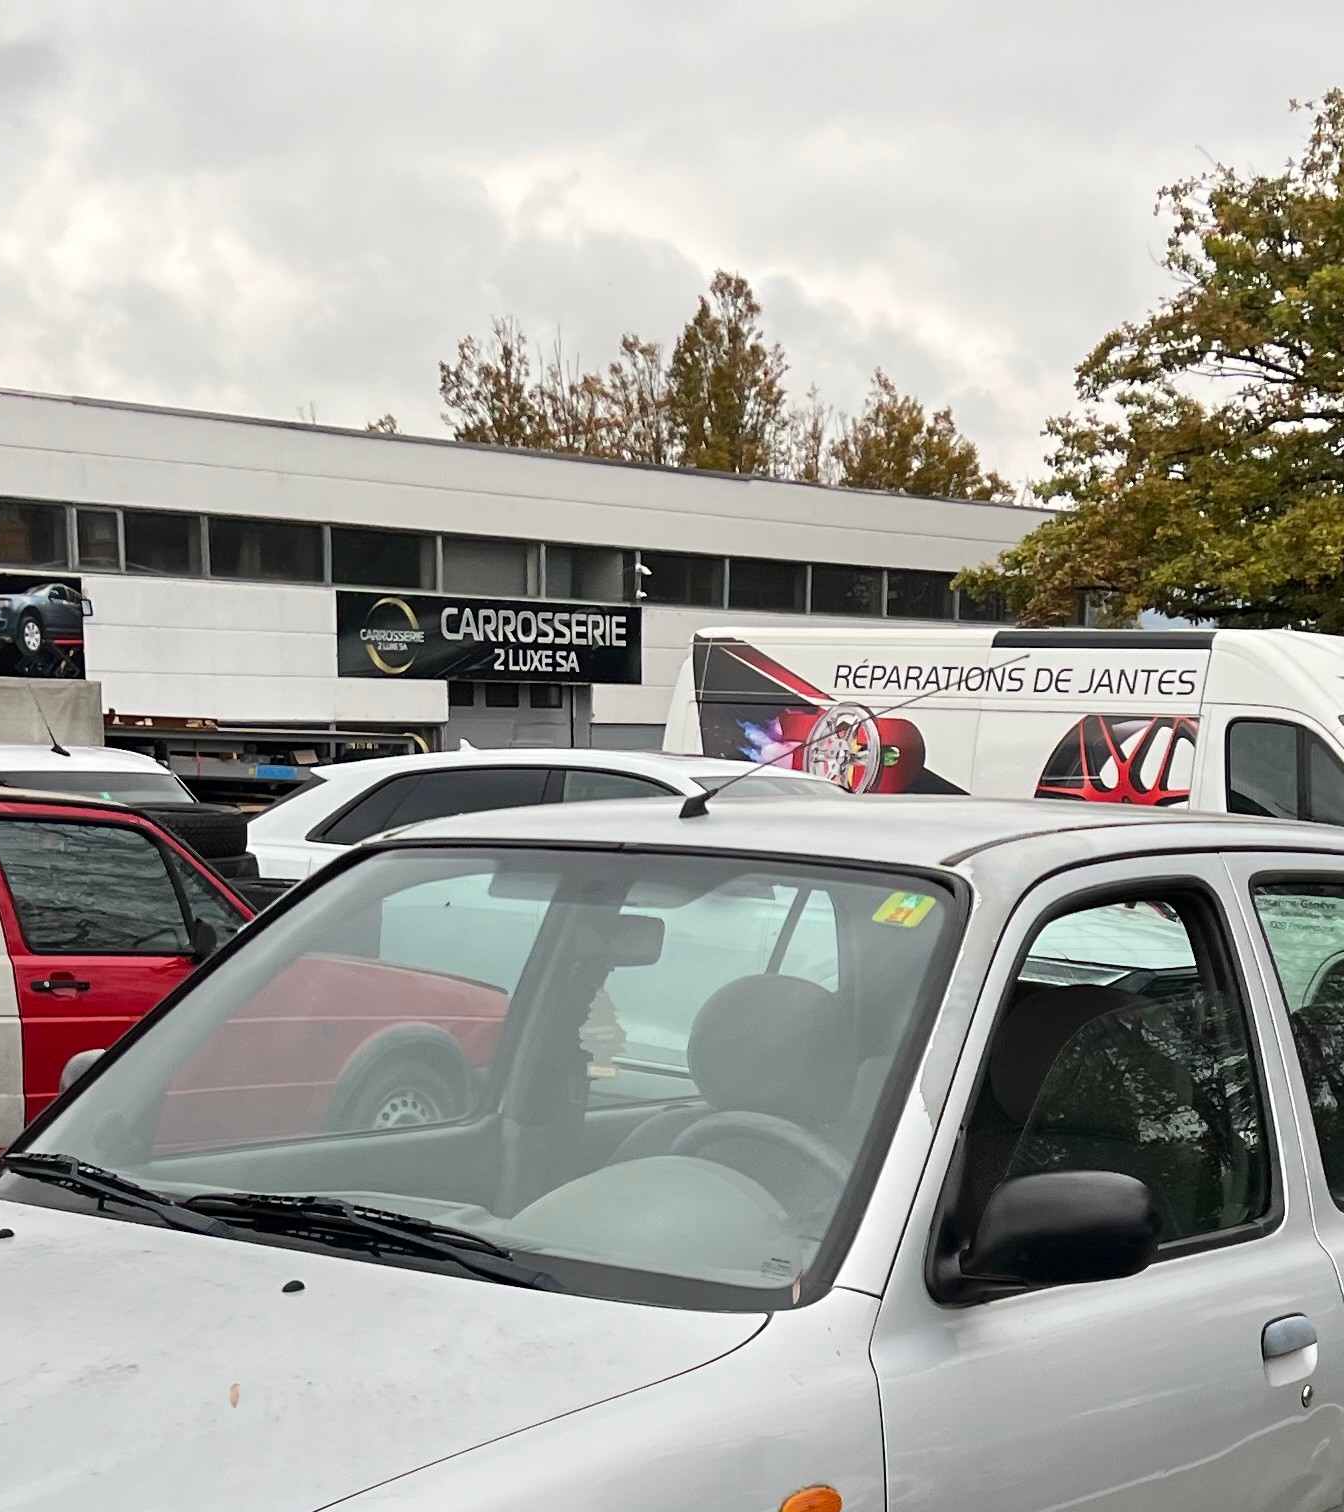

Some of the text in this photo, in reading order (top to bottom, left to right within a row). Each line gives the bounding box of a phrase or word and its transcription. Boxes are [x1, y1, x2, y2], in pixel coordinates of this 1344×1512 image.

[359, 628, 425, 643] CARROSSERIE
[440, 607, 627, 647] CARROSSERIE
[493, 648, 580, 673] 2 LUXE SA
[833, 658, 1198, 696] RÉPARATIONS DE JANTES
